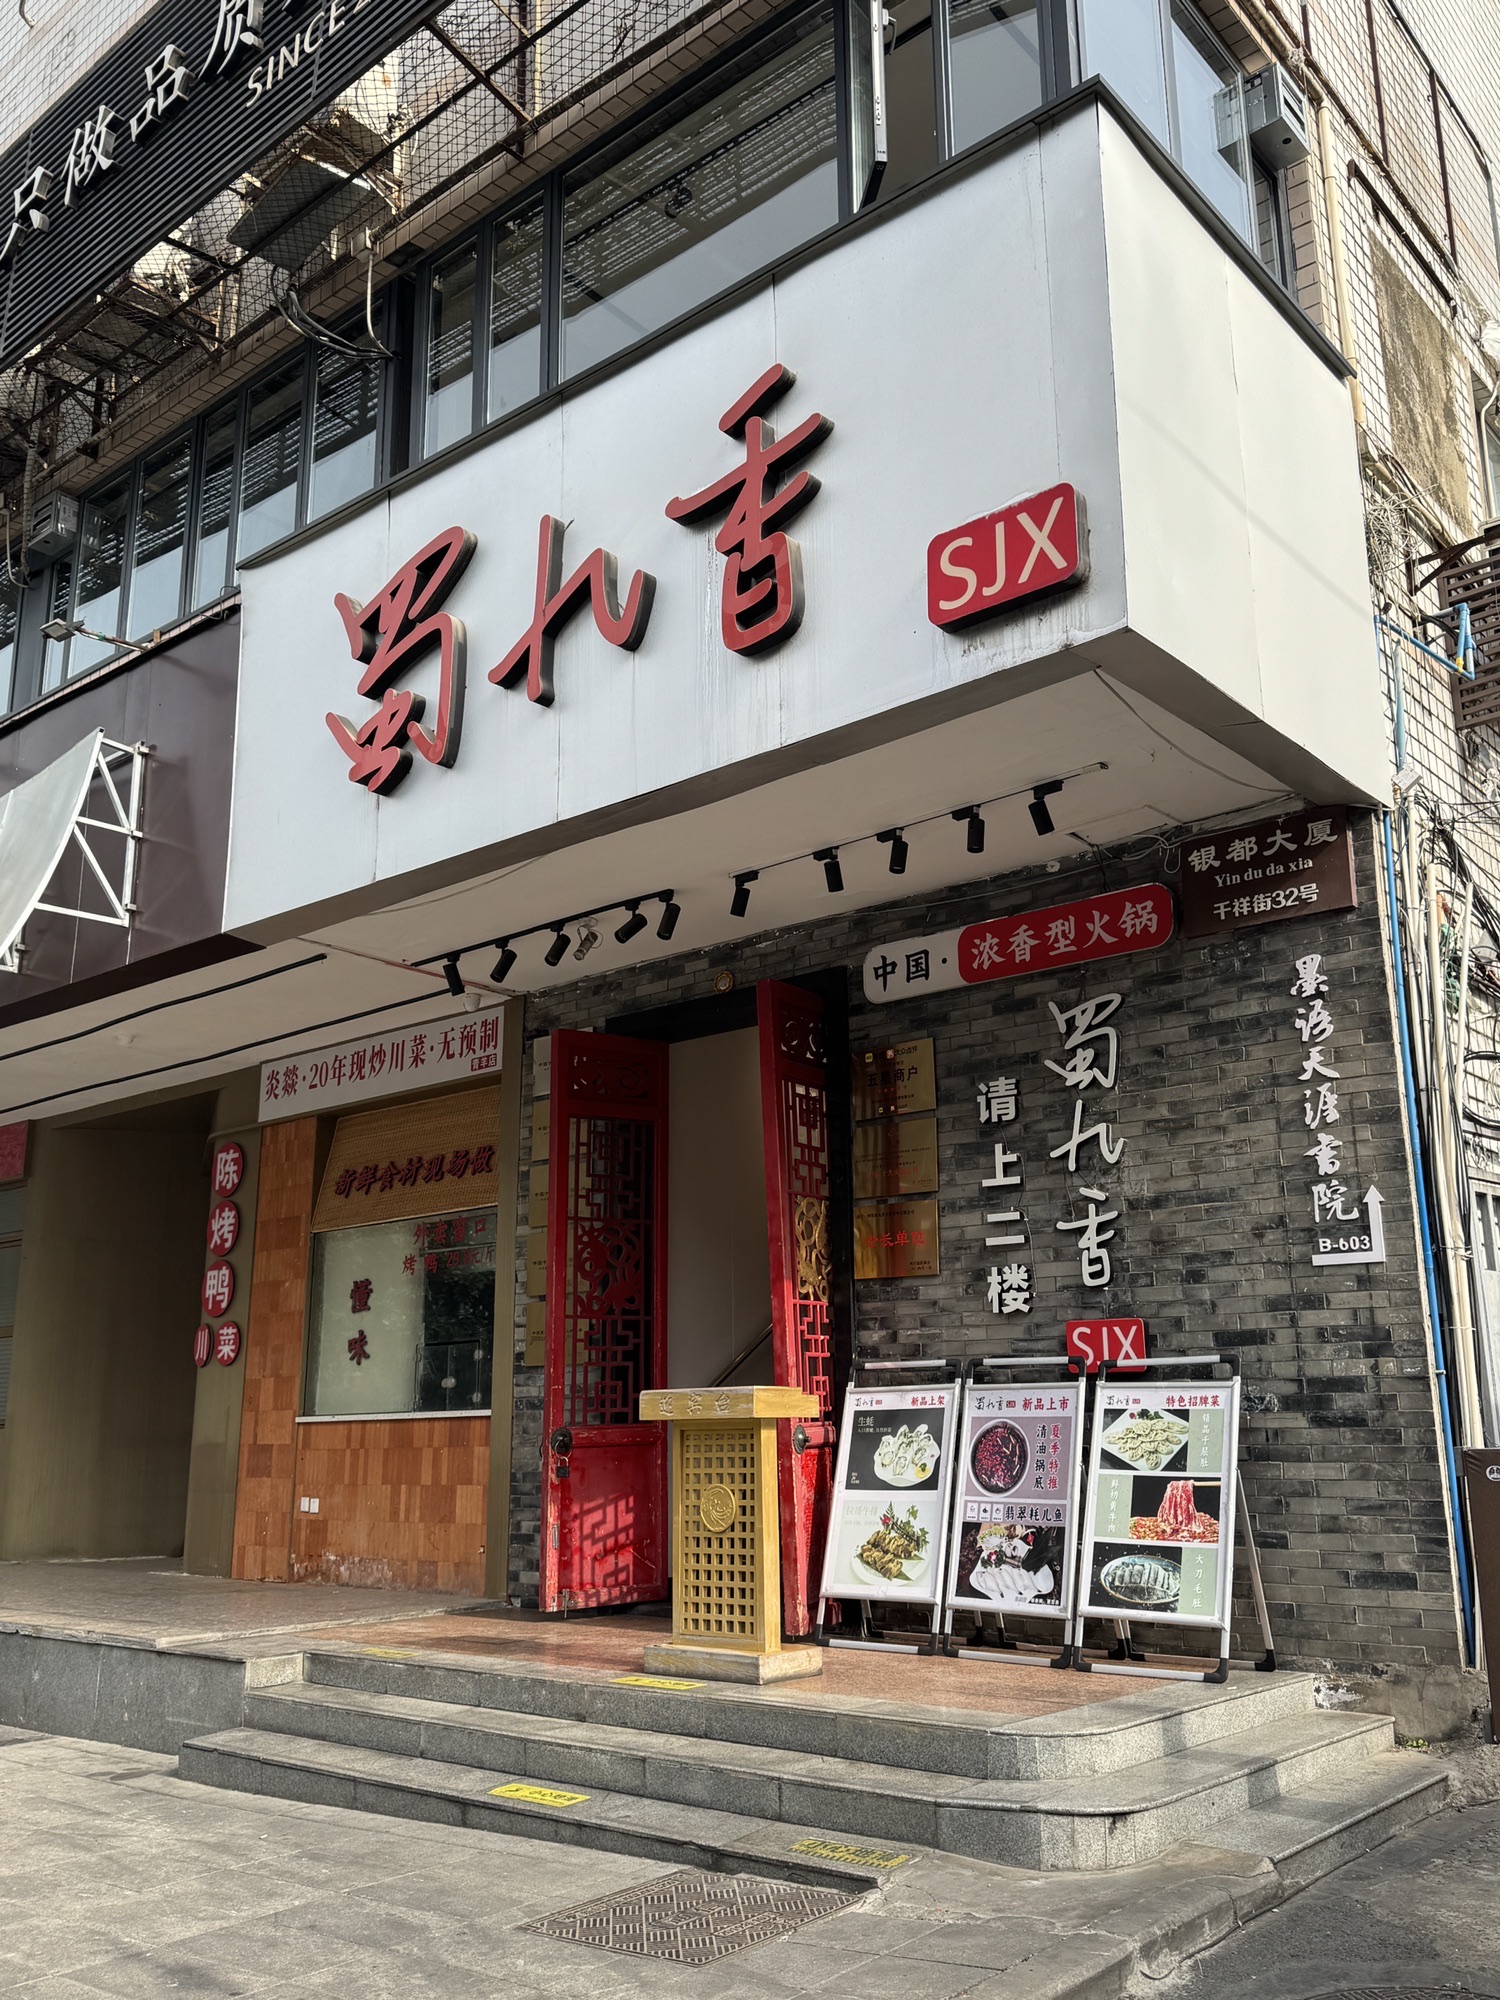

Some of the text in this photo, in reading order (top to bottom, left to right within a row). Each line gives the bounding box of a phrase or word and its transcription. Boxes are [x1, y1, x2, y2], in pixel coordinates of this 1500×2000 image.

[0, 0, 292, 262] 只做品质
[325, 362, 834, 797] 蜀九香
[936, 495, 1069, 612] SJX
[1187, 819, 1339, 873] 银都大厦
[1214, 858, 1314, 888] Yin du da xia
[866, 1066, 918, 1088] 五星商户
[1290, 954, 1359, 1223] 墨语天涯书院
[1043, 992, 1128, 1287] 蜀九香
[335, 1145, 496, 1199] 新鲜食材现场做
[976, 1076, 1031, 1314] 请上二楼
[204, 1149, 239, 1310] 陈烤鸭
[413, 1215, 487, 1247] 外卖窗口
[1318, 1235, 1371, 1252] B-603
[659, 1391, 731, 1416] 迎宾台
[911, 1394, 945, 1407] 新品上架
[1021, 1396, 1070, 1411] 新品上市
[1165, 1394, 1220, 1408] 特色招牌菜
[1032, 1424, 1047, 1491] 清油锅底
[1047, 1423, 1062, 1491] 夏季特推
[1005, 1505, 1064, 1523] 翡翠耗儿鱼
[1191, 1553, 1204, 1609] 大刀毛肚
